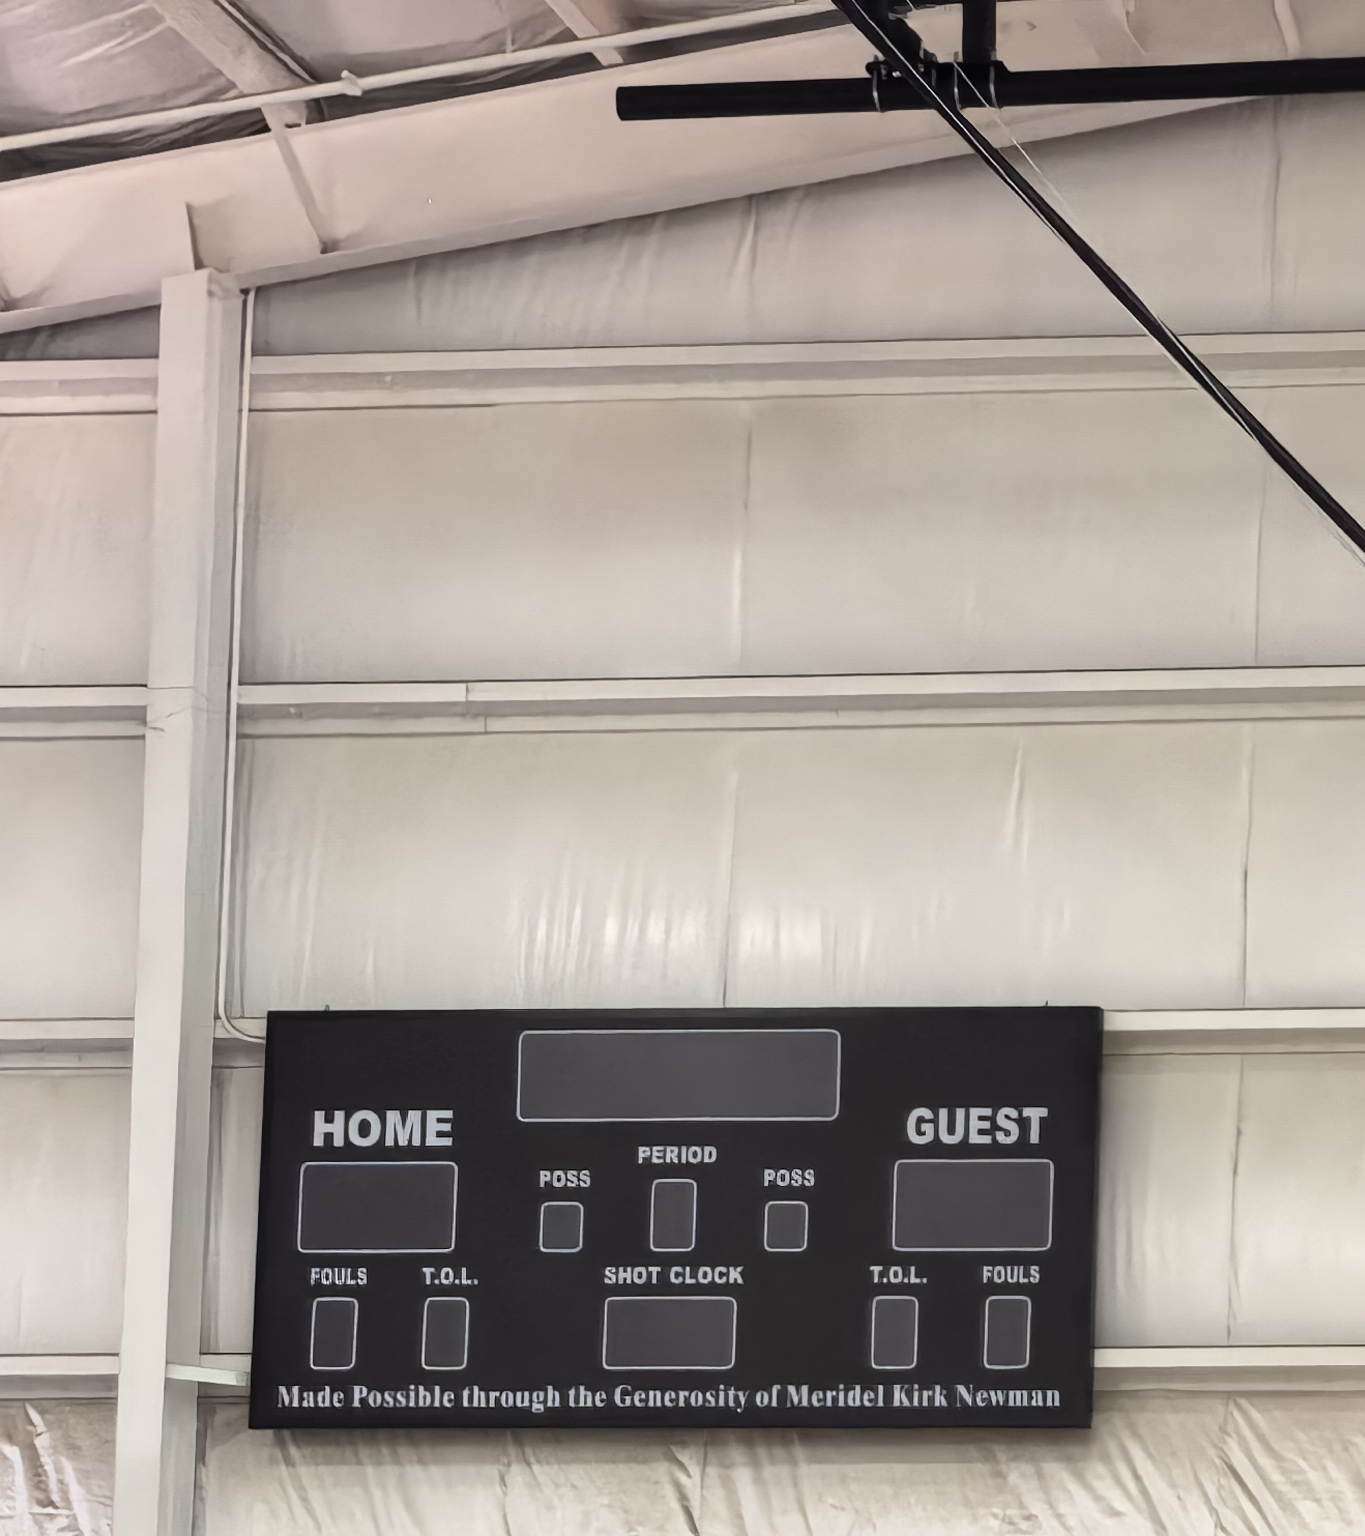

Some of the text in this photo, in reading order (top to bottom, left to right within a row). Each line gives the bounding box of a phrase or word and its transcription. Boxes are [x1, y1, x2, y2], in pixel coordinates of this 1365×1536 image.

[312, 1109, 454, 1148] HOME
[906, 1106, 1049, 1145] GUEST
[637, 1145, 718, 1165] PERIOD
[539, 1169, 591, 1188] POSS
[763, 1168, 815, 1187] POSS
[310, 1267, 368, 1286] FOULS
[421, 1267, 479, 1286] T.O.L.
[603, 1265, 744, 1285] SHOT CLOCK
[869, 1265, 928, 1284] T.O.L.
[982, 1265, 1041, 1284] FOULS
[277, 1383, 1061, 1414] Made Possible through the Generosity of Meridel Kirk Newman
